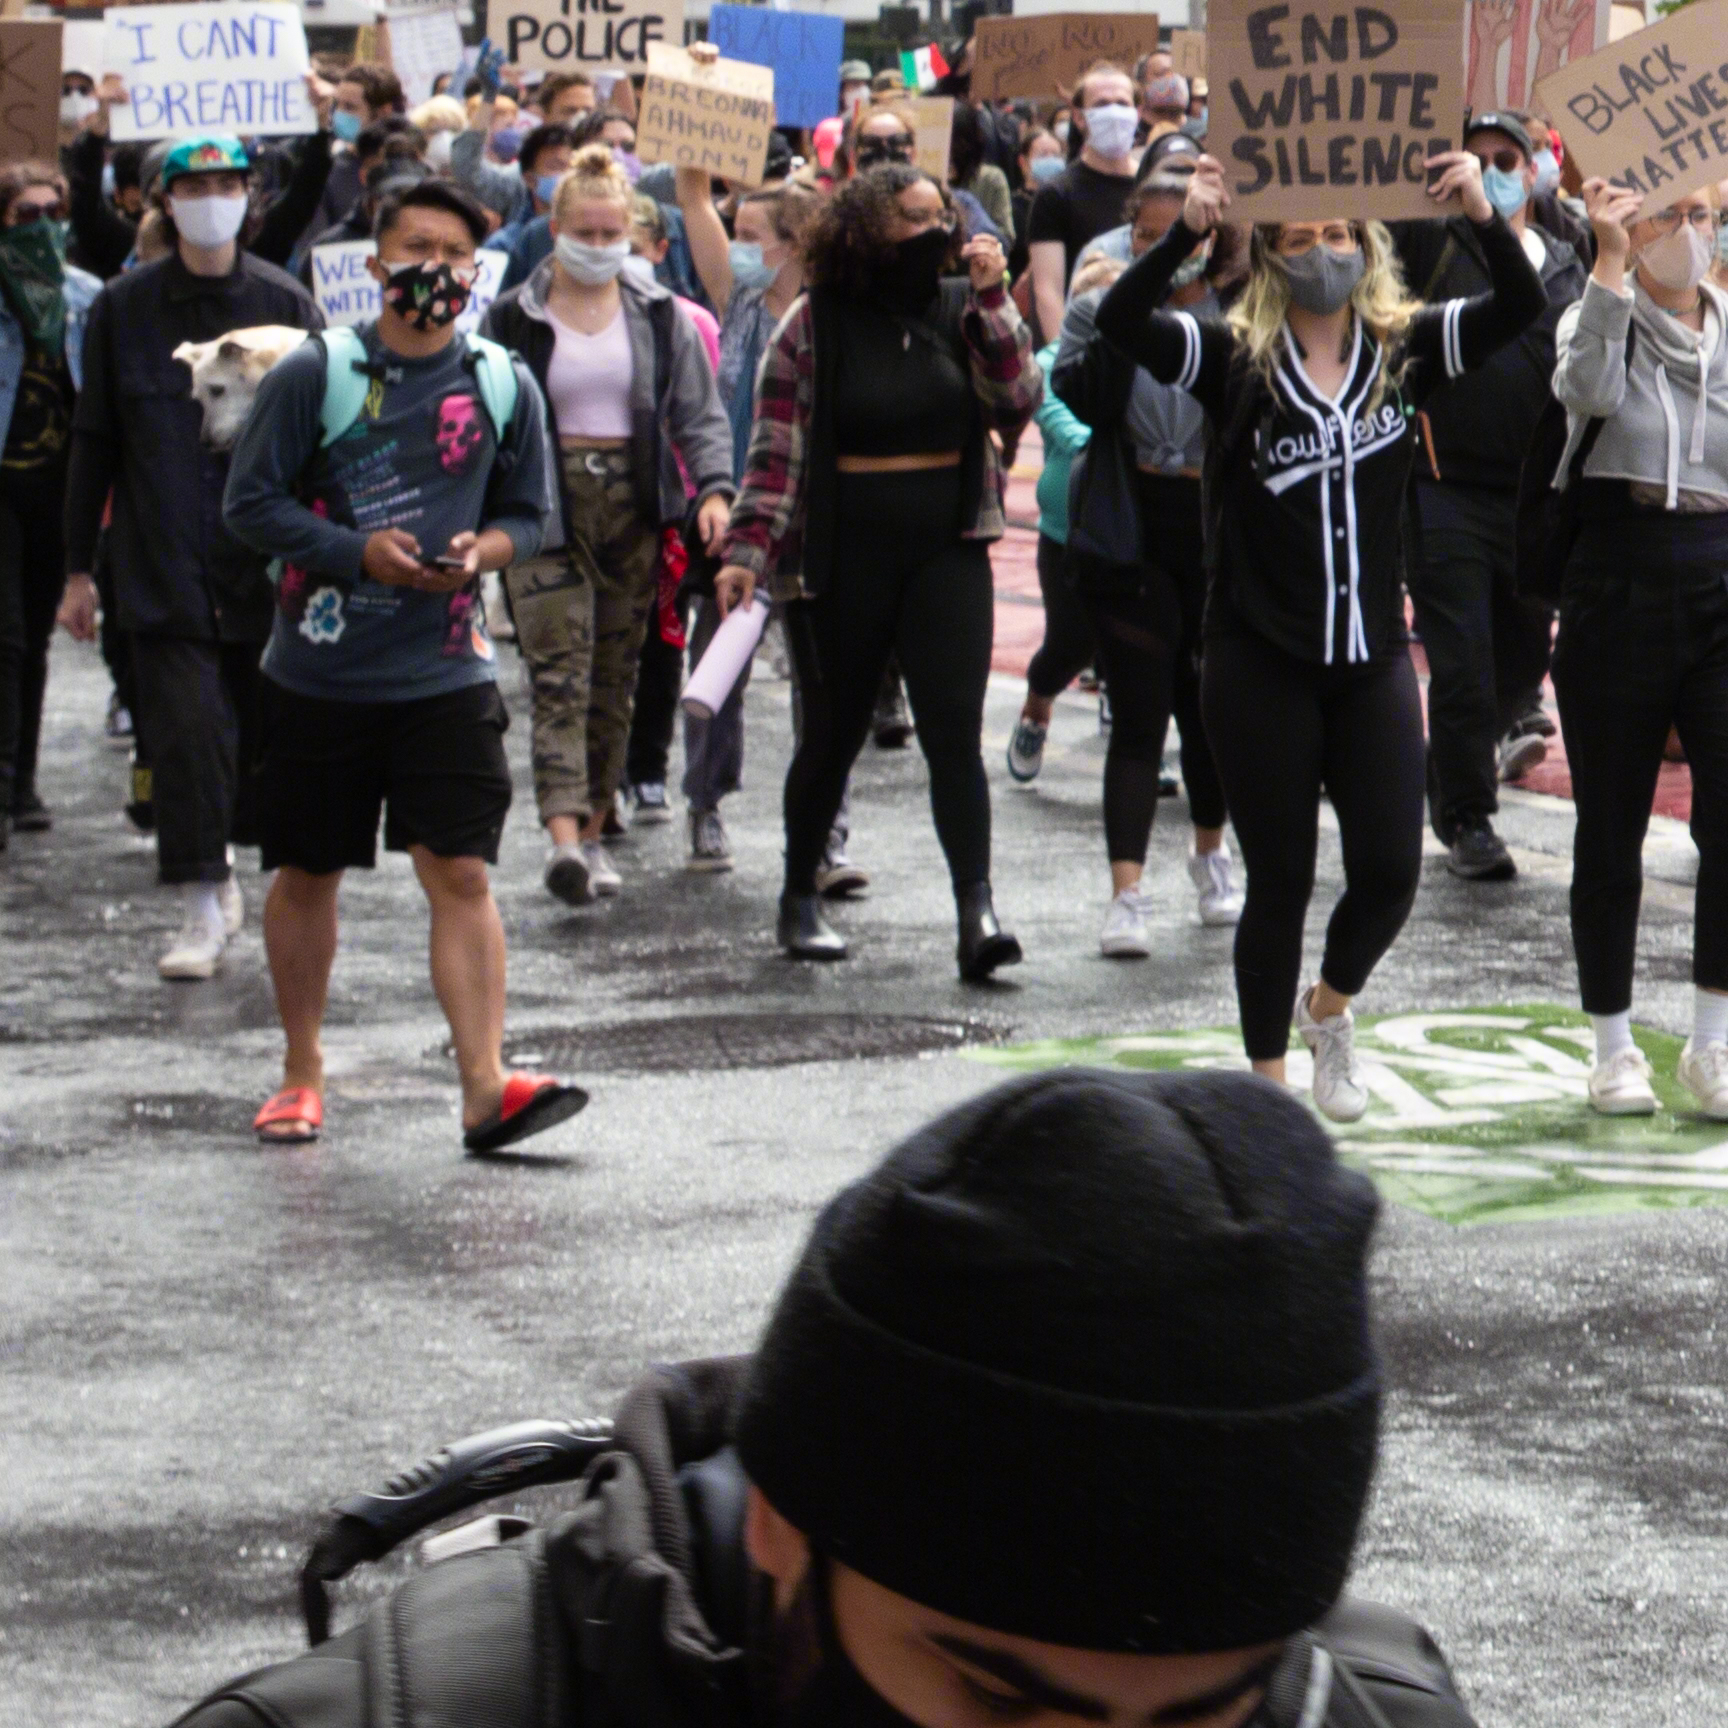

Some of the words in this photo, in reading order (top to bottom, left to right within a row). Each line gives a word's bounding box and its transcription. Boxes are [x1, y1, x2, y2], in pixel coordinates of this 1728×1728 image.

[507, 15, 664, 63] POLICE
[1246, 4, 1399, 71] END
[1229, 71, 1440, 131] WHITE
[1567, 43, 1687, 134] BLACK
[647, 103, 764, 152] AHMAUD
[643, 135, 750, 179] TONY
[1231, 134, 1453, 196] SILENCE
[316, 252, 365, 285] WE
[321, 288, 383, 317] WITH
